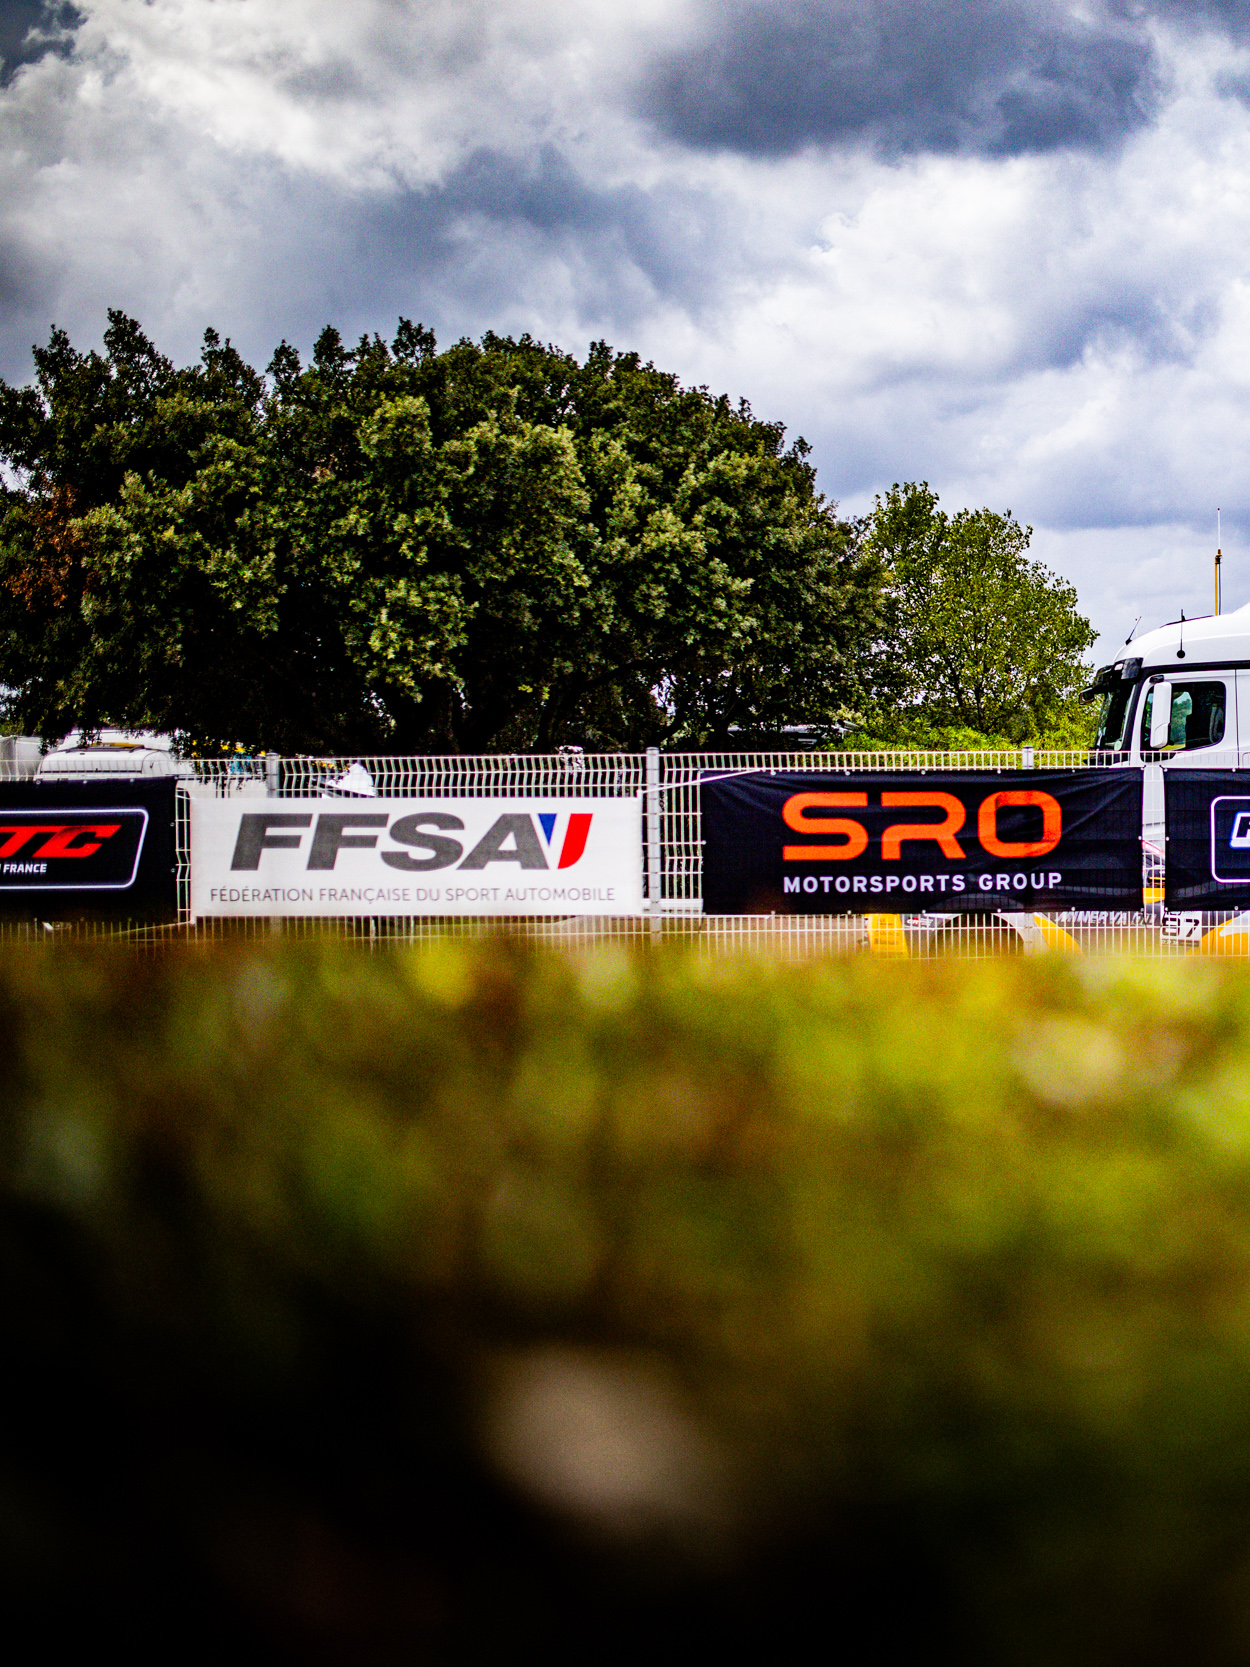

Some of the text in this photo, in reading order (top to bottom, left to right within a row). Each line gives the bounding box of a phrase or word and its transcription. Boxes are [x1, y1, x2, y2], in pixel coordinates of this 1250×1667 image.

[782, 790, 1062, 861] SRO
[0, 825, 121, 858] TC
[230, 812, 550, 871] FFSA
[3, 863, 47, 873] FRANCE
[210, 885, 616, 904] FÉDÉRATION FRANÇAISE DU SPORT AUTOMOBILE
[783, 872, 1063, 894] MOTORSPORTS GROUP
